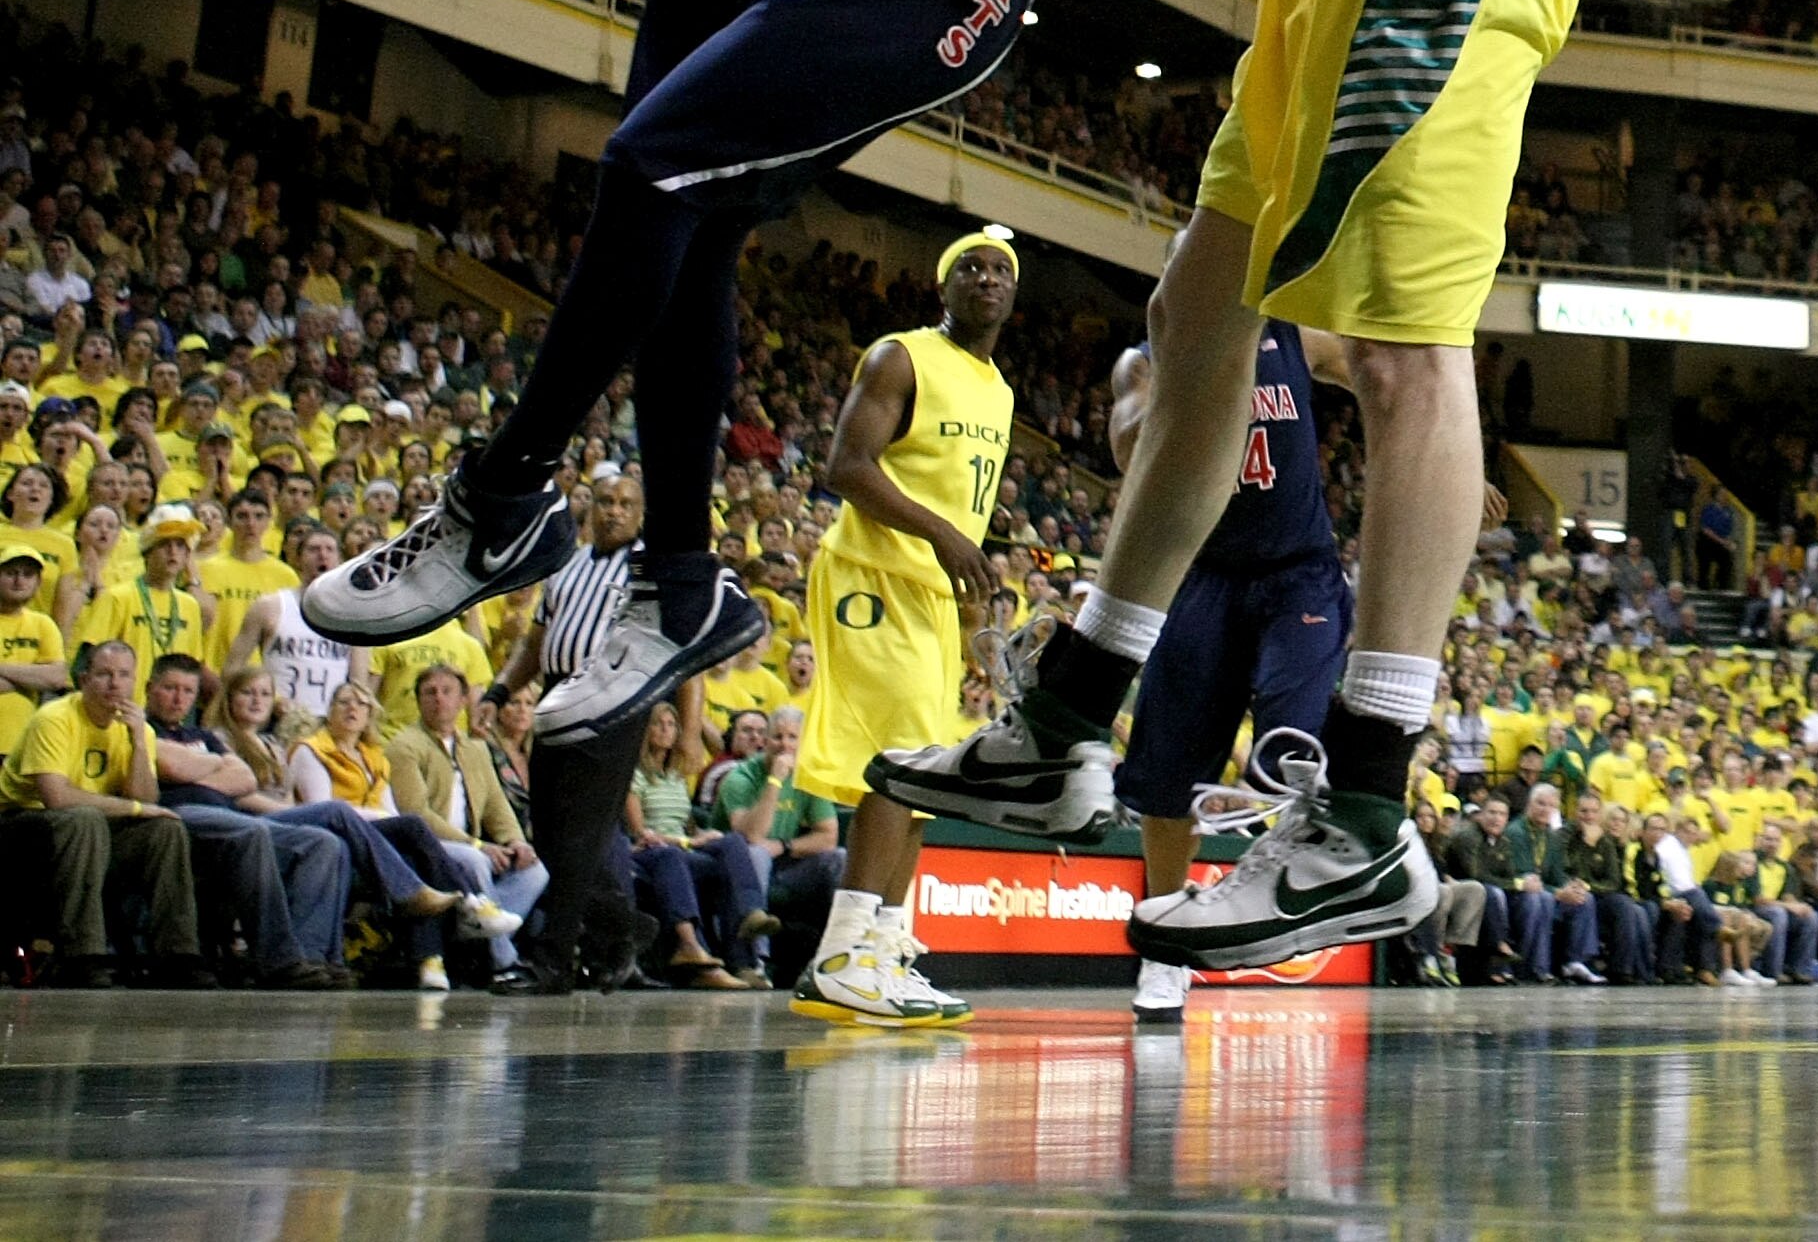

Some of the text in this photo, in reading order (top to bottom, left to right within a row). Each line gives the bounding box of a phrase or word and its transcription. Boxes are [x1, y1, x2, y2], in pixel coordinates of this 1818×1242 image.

[940, 421, 1011, 452] DUCK
[968, 453, 996, 516] 12
[1581, 472, 1620, 507] 15
[285, 665, 330, 704] 34
[919, 873, 1135, 927] NeuroSpine Institute
